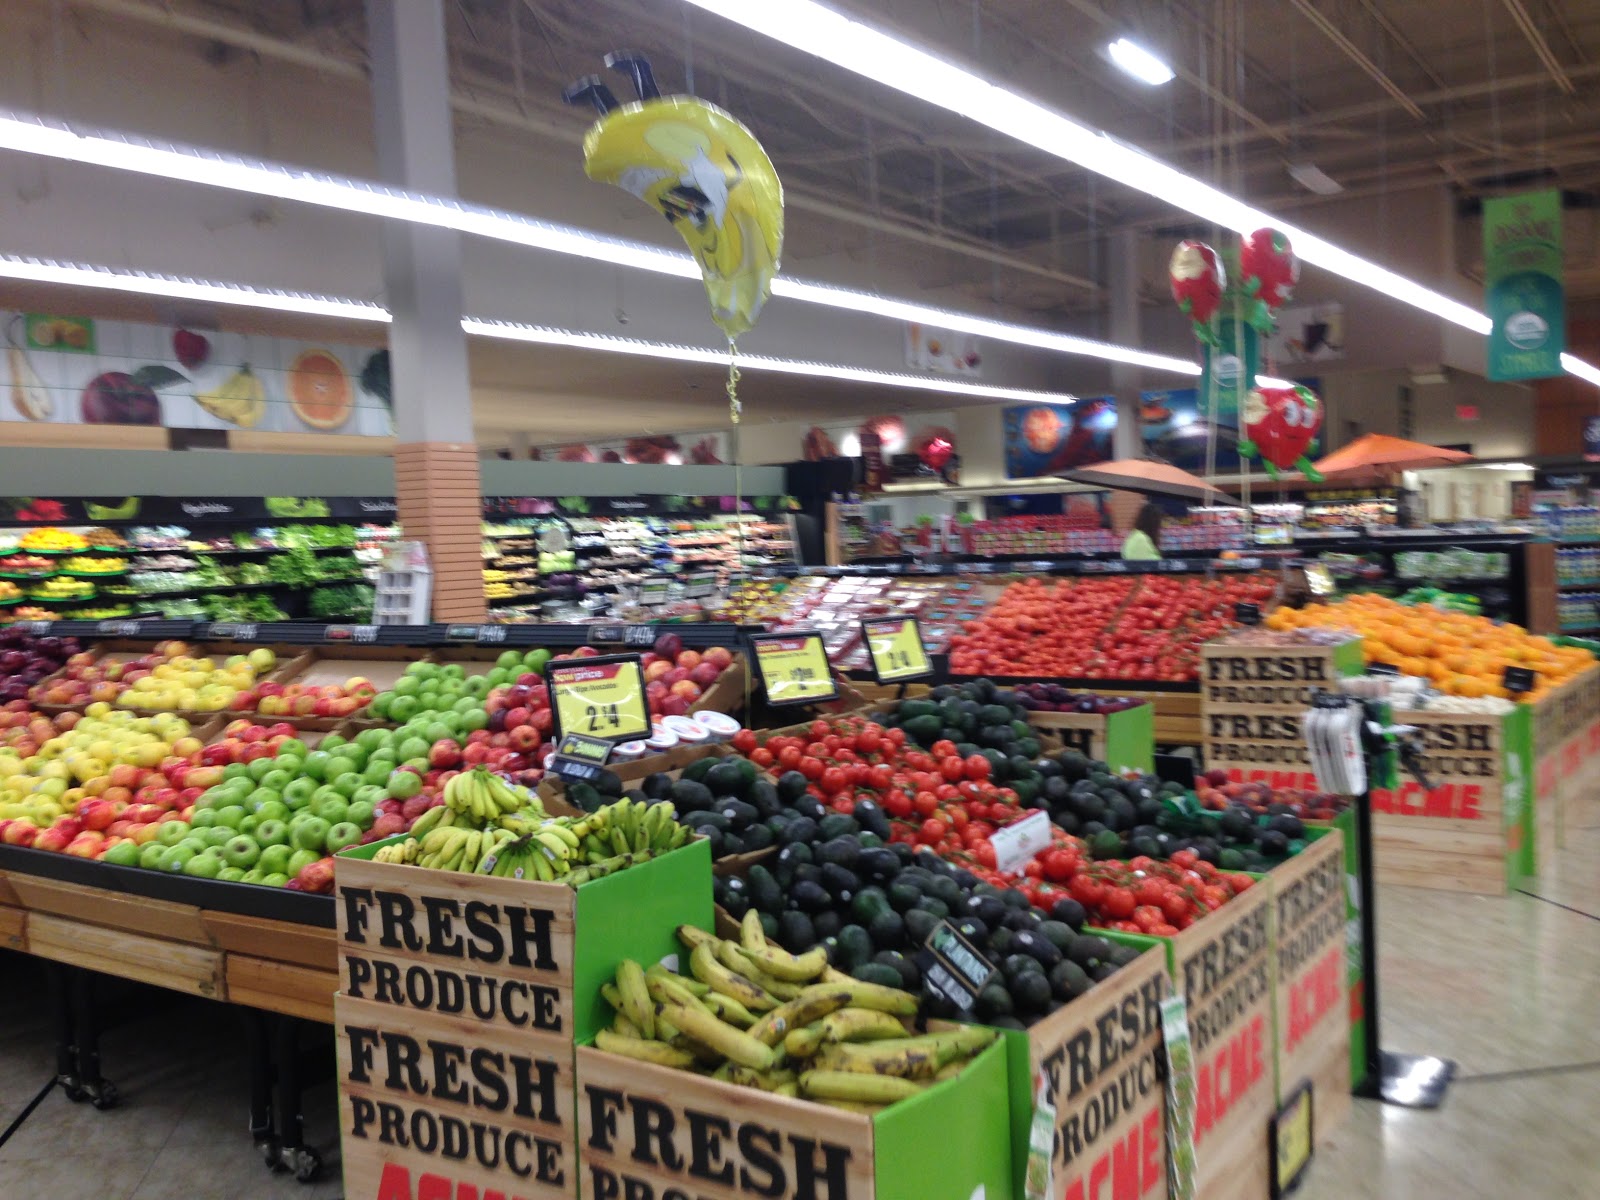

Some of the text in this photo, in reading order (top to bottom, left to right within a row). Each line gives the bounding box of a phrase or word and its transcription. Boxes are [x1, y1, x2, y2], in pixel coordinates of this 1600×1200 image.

[1206, 656, 1325, 681] FRESH
[1208, 713, 1300, 740] FRES
[1211, 742, 1311, 764] PRODUC
[340, 886, 559, 971] FRESH
[345, 955, 563, 1033] PRODUCE
[344, 1025, 563, 1126] FRESH
[1041, 970, 1163, 1107] FRESH
[350, 1095, 565, 1188] PRODUCE
[584, 1083, 853, 1200] FRESH
